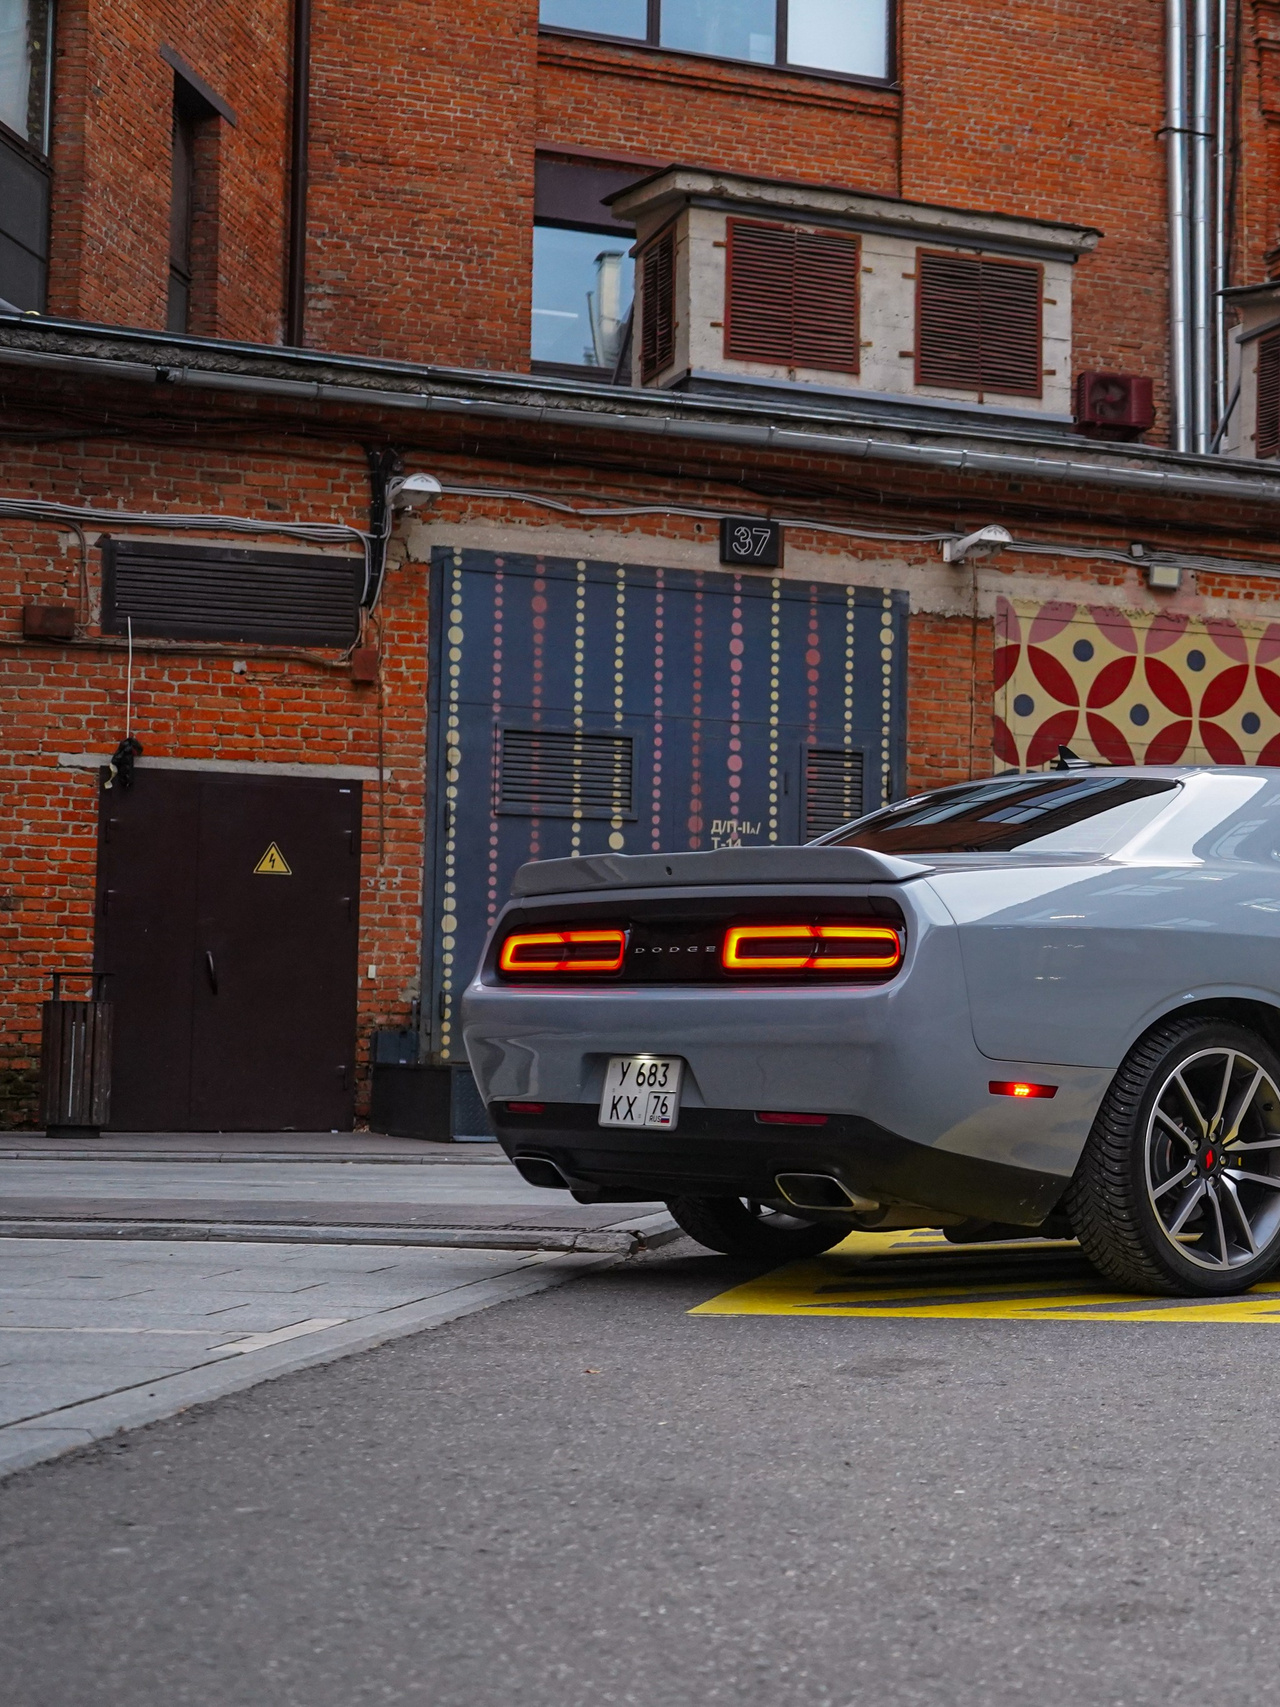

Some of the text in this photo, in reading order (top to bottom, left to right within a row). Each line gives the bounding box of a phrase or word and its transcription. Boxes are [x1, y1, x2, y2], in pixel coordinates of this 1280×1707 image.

[732, 526, 771, 557] 37
[635, 946, 716, 954] DODGE
[636, 1063, 670, 1087] 683
[652, 1096, 668, 1115] 76
[649, 1115, 661, 1123] RUS
